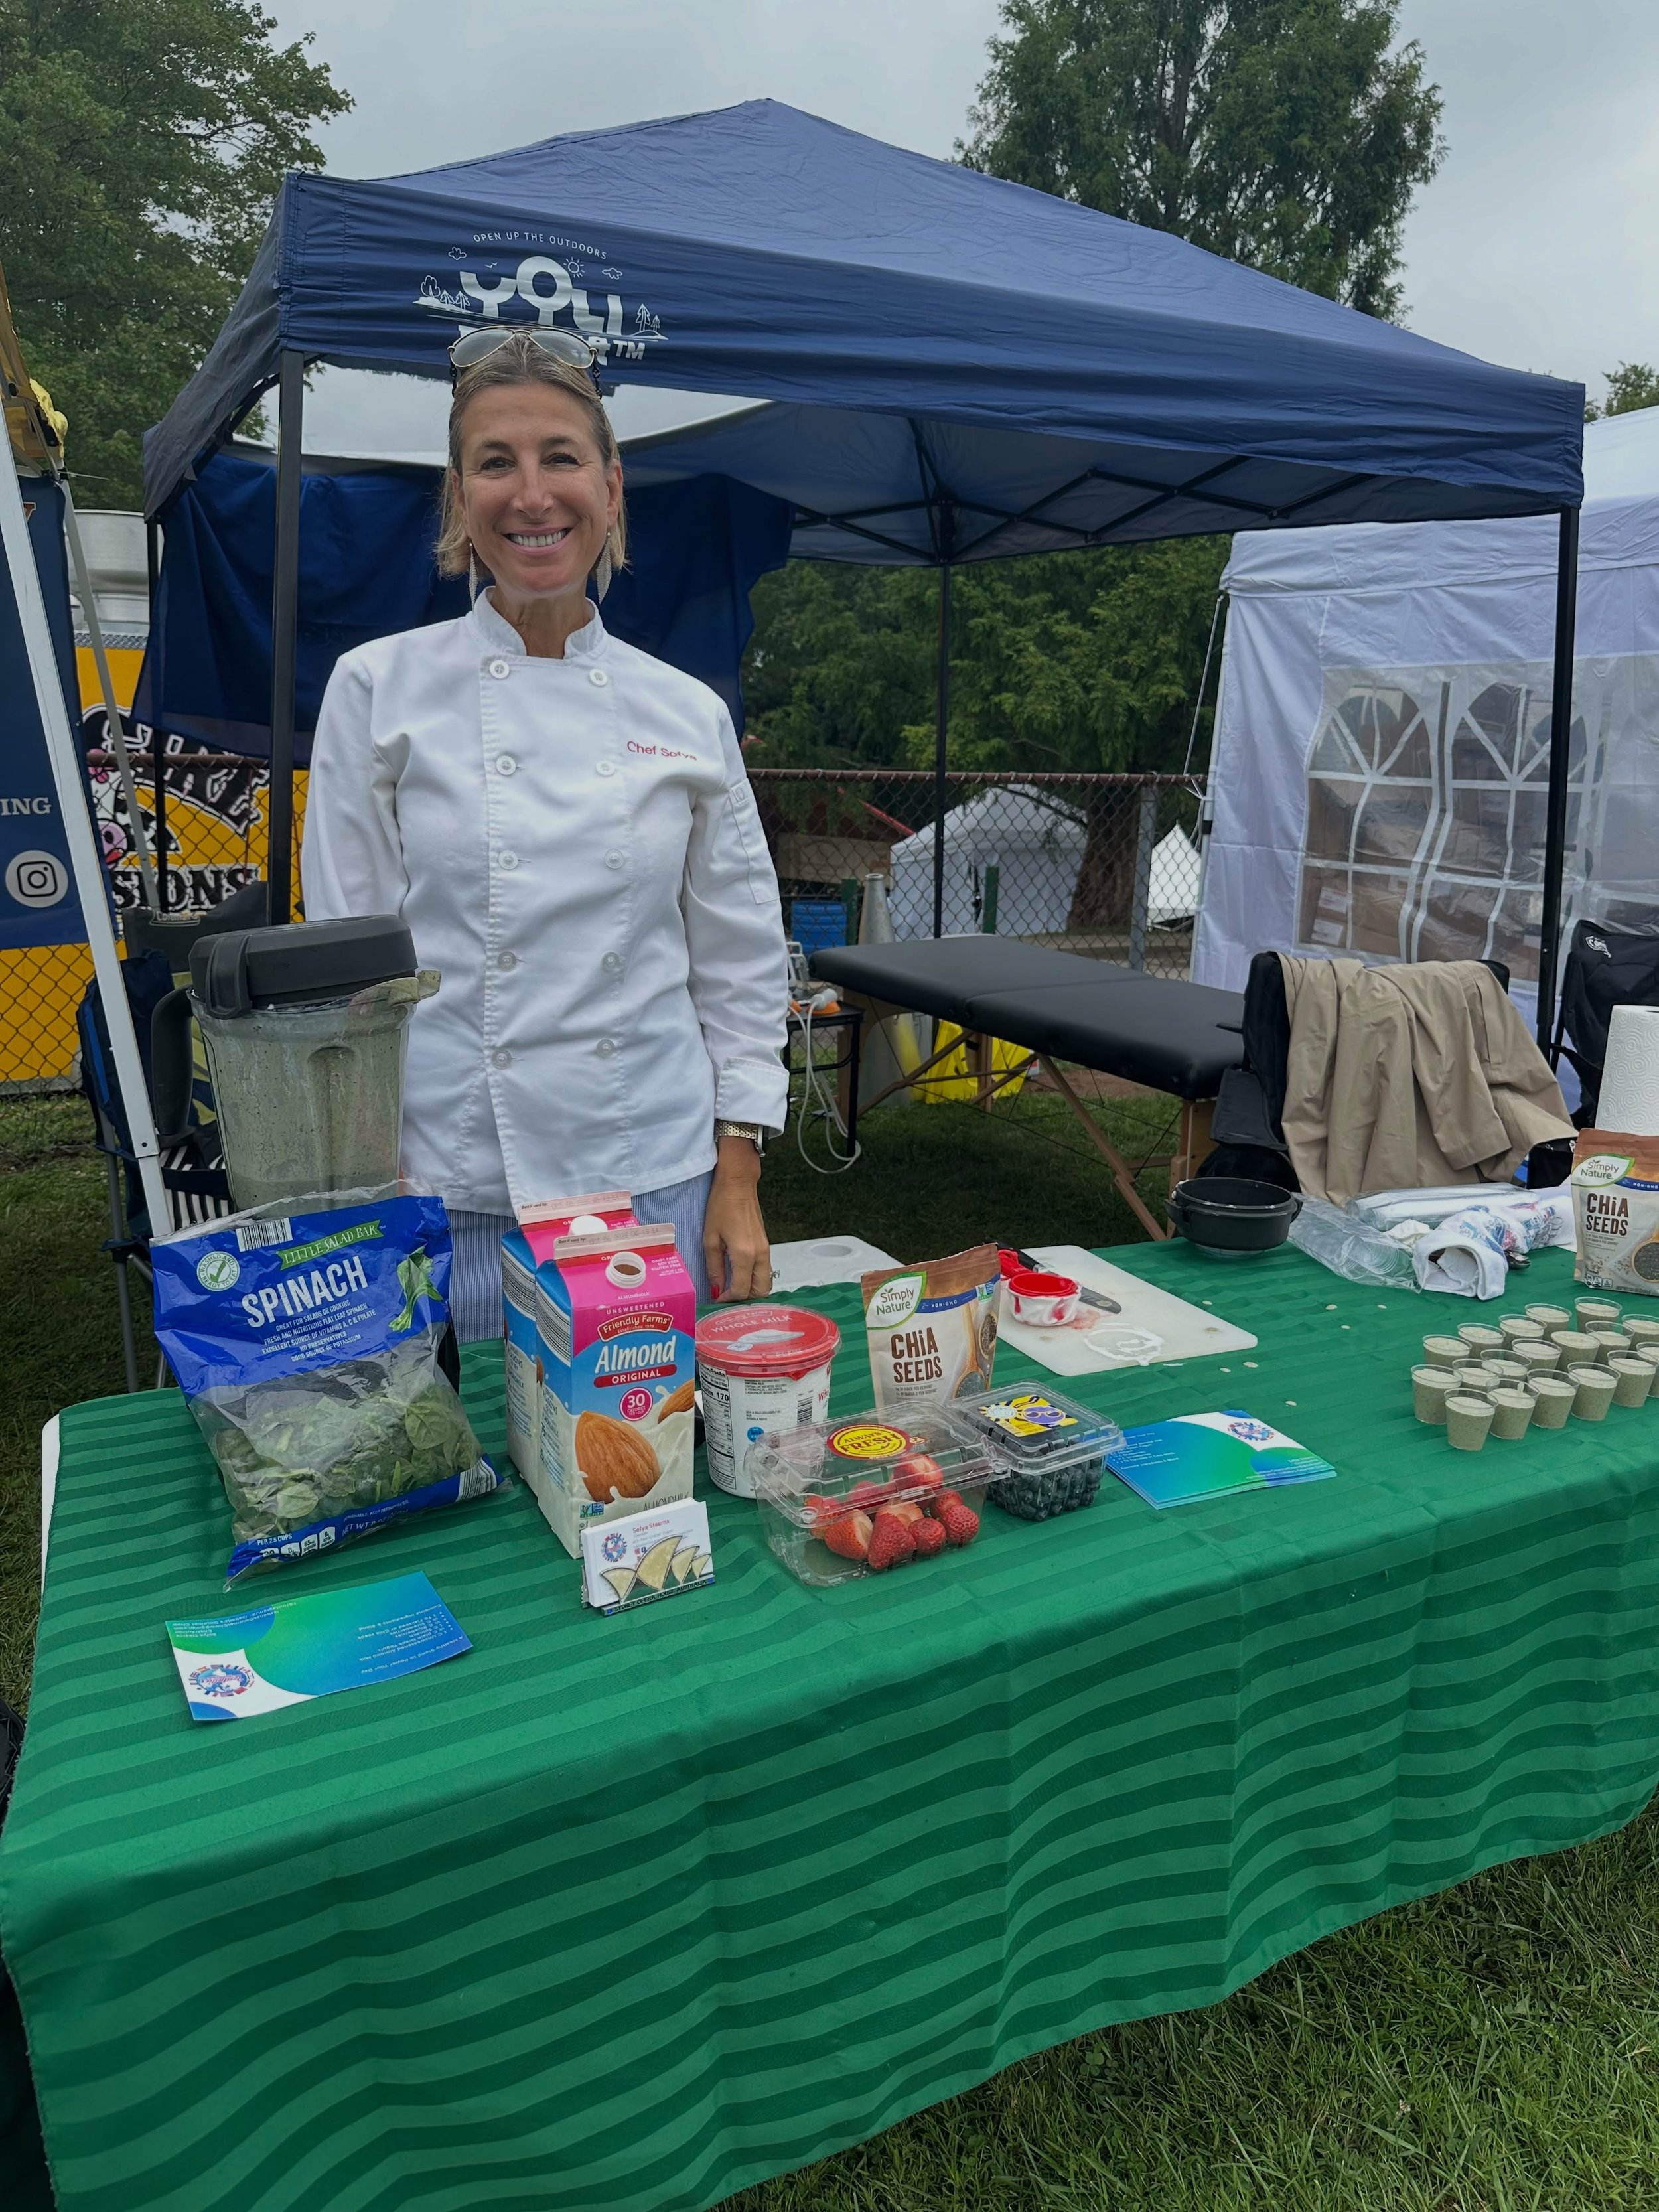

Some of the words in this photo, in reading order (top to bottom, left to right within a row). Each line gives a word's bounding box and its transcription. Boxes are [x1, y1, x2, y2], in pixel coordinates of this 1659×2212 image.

[473, 232, 502, 242] OPEN
[506, 232, 520, 240] UP
[524, 232, 544, 242] THE
[549, 236, 607, 259] OUTDOORS
[627, 741, 657, 755] Chef
[1587, 1162, 1619, 1174] Simply
[1586, 1214, 1628, 1236] SEEDS
[283, 1243, 323, 1264] LITTLE
[324, 1231, 354, 1252] SALAD
[356, 1224, 378, 1239] BAR
[200, 1254, 221, 1273] WASHED
[222, 1255, 235, 1266] AND
[202, 1276, 220, 1288] READY
[242, 1256, 368, 1327] SPINACH
[618, 1291, 650, 1301] ALMONDMILK
[880, 1288, 914, 1303] Simply
[275, 1321, 293, 1332] GREAT
[293, 1317, 303, 1326] FOR
[303, 1310, 323, 1323] SALADS
[330, 1299, 351, 1313] COOKING
[607, 1301, 665, 1315] UNSWEETENED
[264, 1335, 281, 1345] FRESH
[281, 1330, 293, 1340] AND
[293, 1321, 323, 1335] NUTRITIOUS
[323, 1316, 334, 1326] FLAT
[334, 1311, 346, 1322] LEAF
[346, 1303, 368, 1317] SPINACH
[603, 1315, 640, 1333] Friendly
[711, 1320, 760, 1333] WHOLE
[762, 1315, 792, 1323] MILK
[261, 1342, 291, 1355] EXCELLENT
[291, 1335, 311, 1346] SOURCE
[318, 1323, 343, 1338] VITAMINS
[357, 1309, 377, 1321] FOLATE
[308, 1331, 348, 1349] PRESERVATIVES
[291, 1353, 305, 1362] GOOD
[306, 1347, 326, 1358] SOURCE
[333, 1334, 362, 1349] POTASSIUM
[594, 1335, 676, 1374] Almond
[611, 1370, 661, 1384] ORIGINAL
[893, 1356, 943, 1383] SEEDS
[627, 1393, 646, 1408] 30
[717, 1392, 729, 1402] 170
[839, 1434, 901, 1453] FRESH
[844, 1432, 882, 1443] ALWAYS
[342, 1523, 354, 1537] NET
[356, 1521, 370, 1530] WT
[632, 1524, 649, 1534] Sofya
[649, 1519, 670, 1529] Stearns
[277, 1533, 293, 1542] CUPS
[614, 1601, 636, 1611] SYDNEY
[636, 1594, 656, 1605] OPERA
[657, 1589, 674, 1598] HOUSE
[676, 1580, 707, 1592] AUSTRALIA
[416, 1603, 442, 1615] Combine
[378, 1644, 398, 1653] Yogurt
[397, 1635, 437, 1651] Unsweetened
[399, 1637, 417, 1646] Greek
[435, 1639, 458, 1650] Healthy
[373, 1649, 396, 1658] Almond
[390, 1658, 409, 1666] Power
